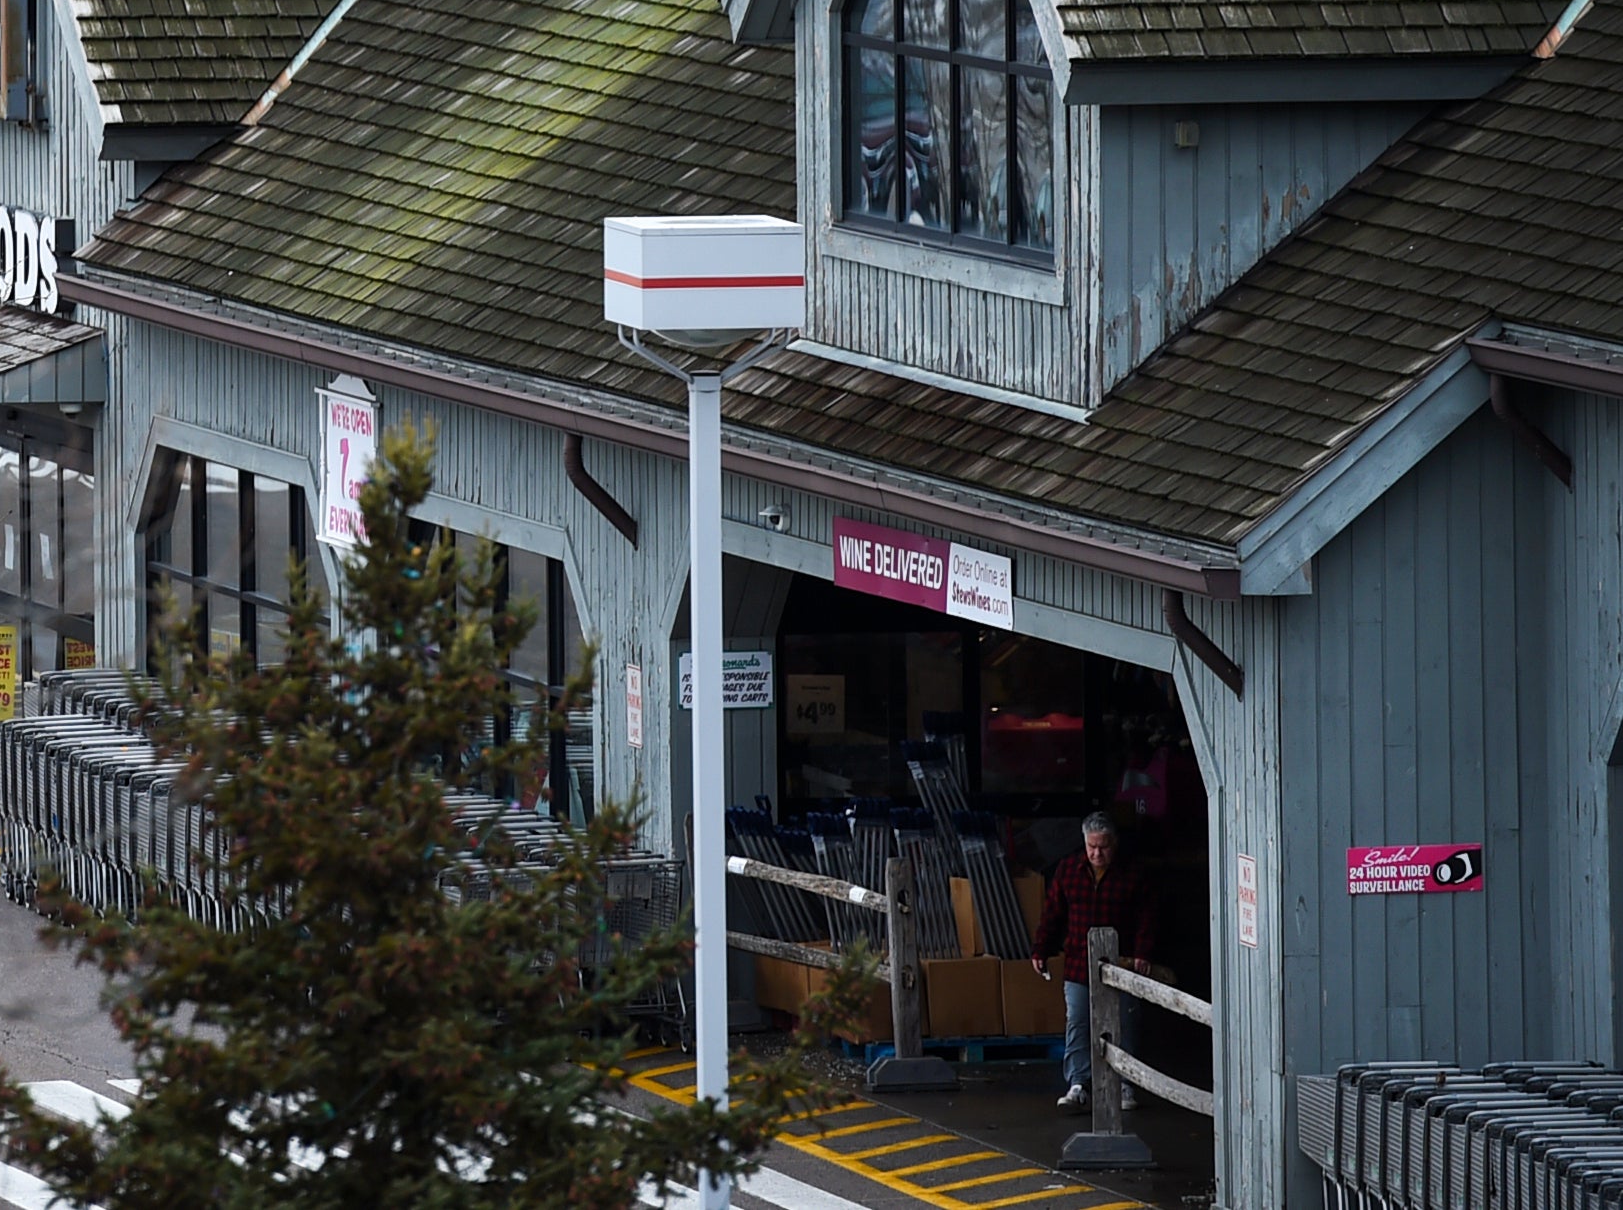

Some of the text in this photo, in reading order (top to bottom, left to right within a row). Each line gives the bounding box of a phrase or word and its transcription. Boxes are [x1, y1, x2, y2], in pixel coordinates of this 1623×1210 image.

[330, 402, 372, 437] WE'RE OPEN
[339, 437, 350, 498] 7
[839, 535, 944, 590] WINE DELIVERED
[953, 554, 1008, 588] Order Online at
[952, 581, 1009, 616] StewsWines.com
[741, 693, 768, 703] CARTS
[747, 682, 765, 692] DUE
[1361, 846, 1420, 868] Smile!
[1349, 864, 1431, 880] 24 HOUR VIDEO
[1349, 879, 1425, 894] SURVEILLANCE
